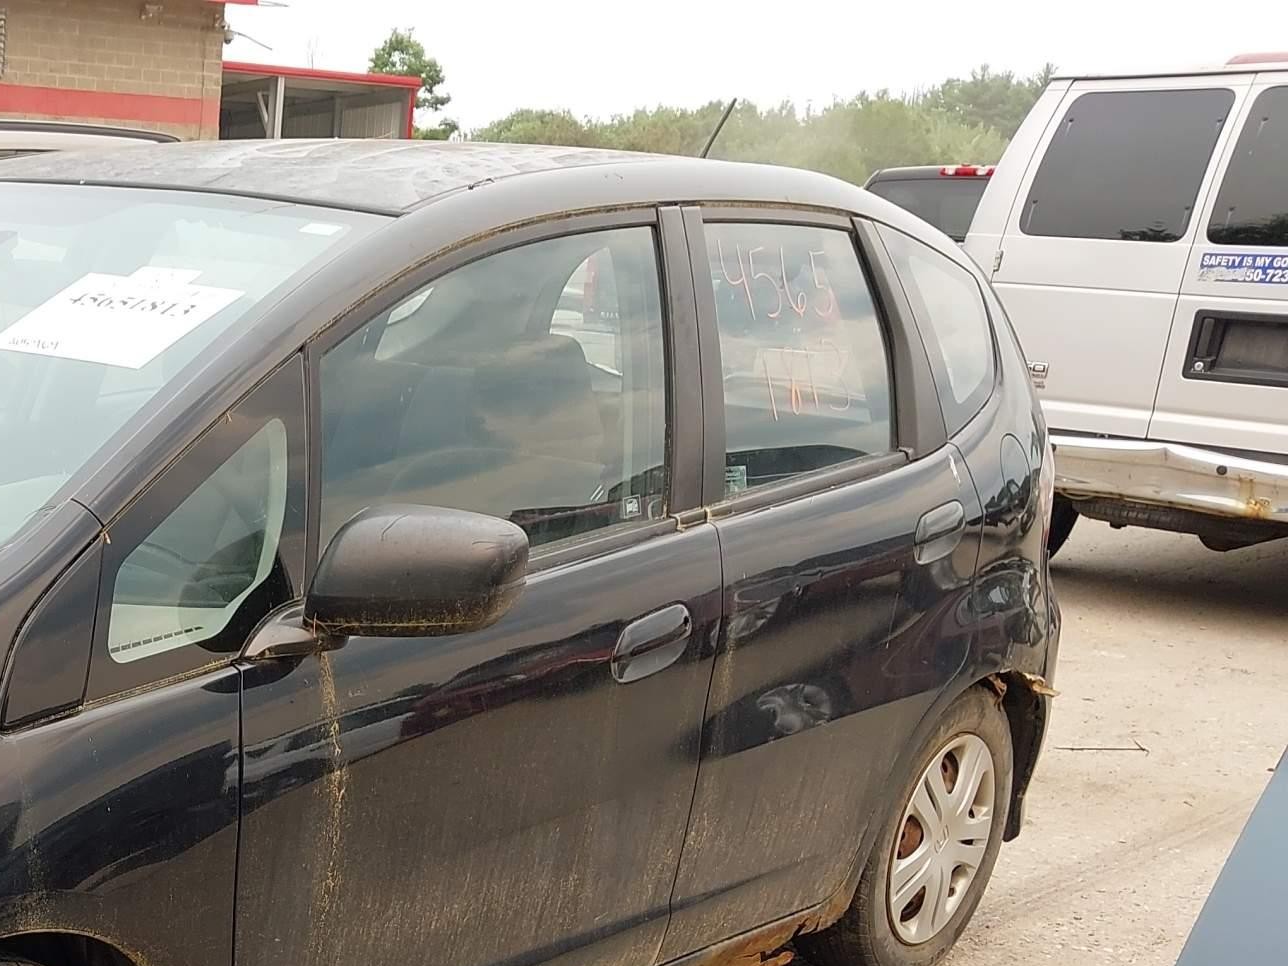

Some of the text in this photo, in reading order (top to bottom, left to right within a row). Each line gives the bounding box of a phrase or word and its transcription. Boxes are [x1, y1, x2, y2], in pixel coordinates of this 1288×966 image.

[716, 238, 834, 321] 4565
[1203, 255, 1242, 266] SAFETY
[1242, 255, 1253, 266] IS
[1255, 256, 1272, 267] MY
